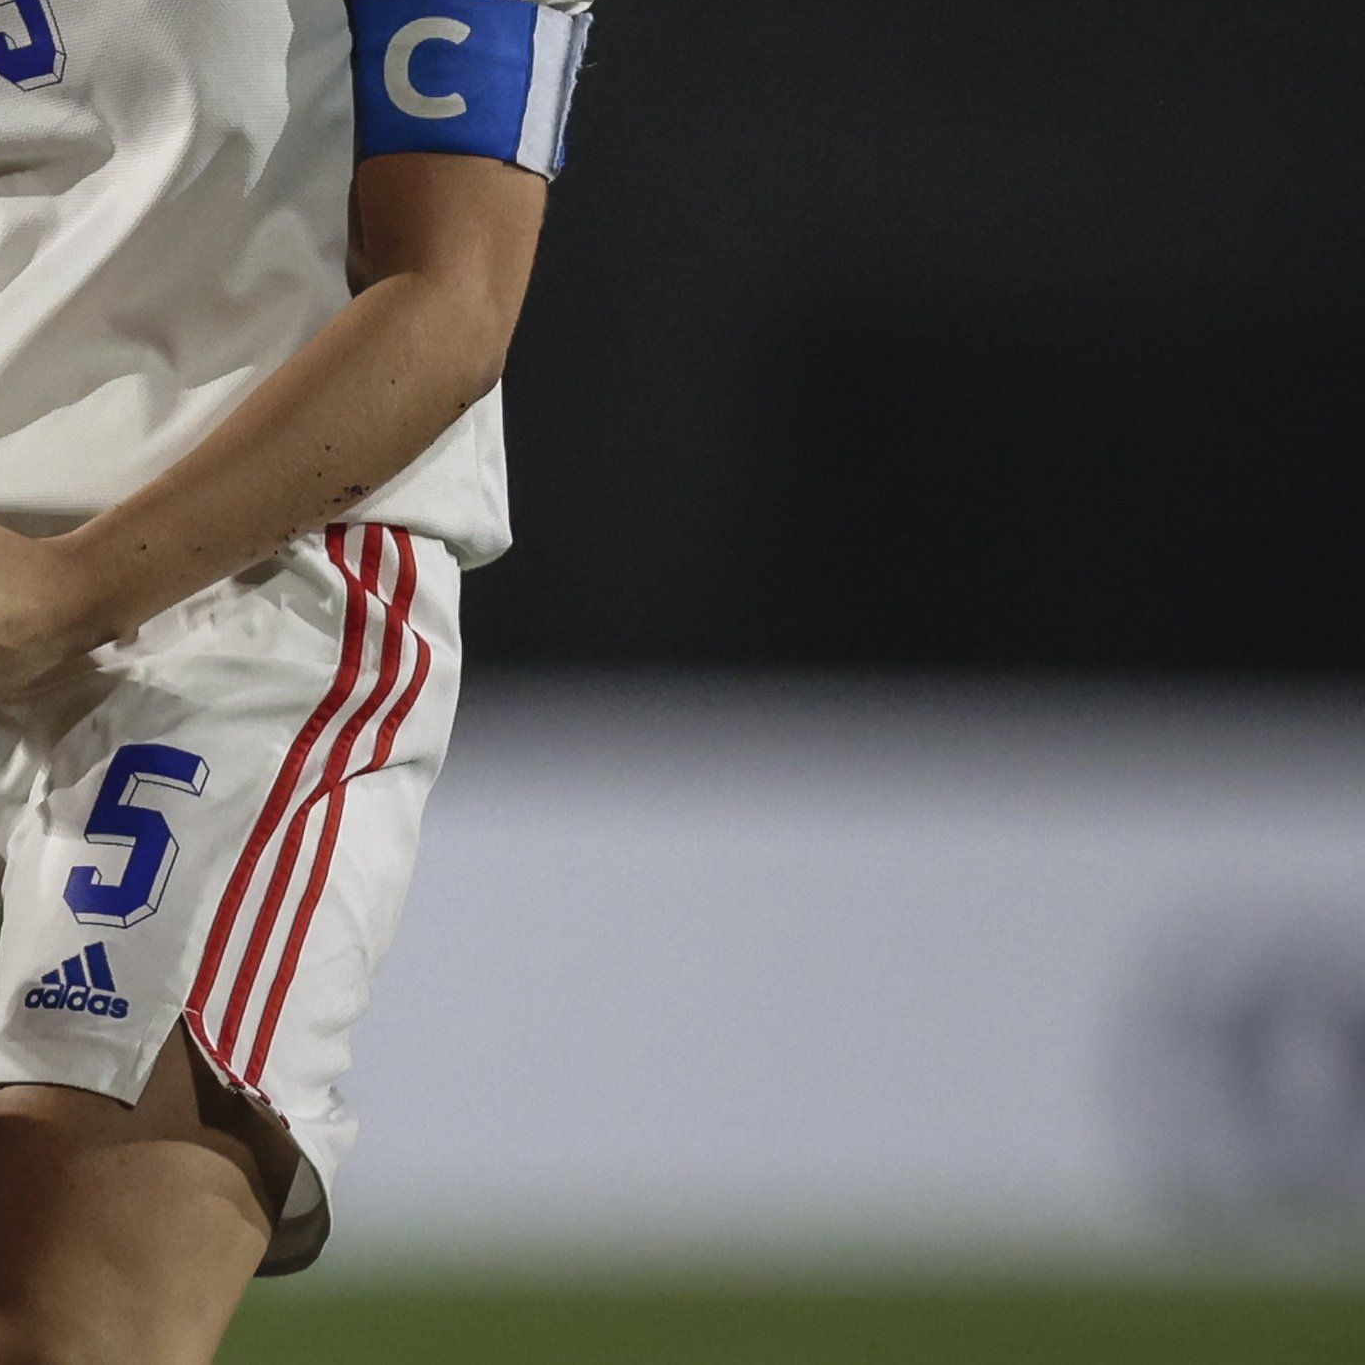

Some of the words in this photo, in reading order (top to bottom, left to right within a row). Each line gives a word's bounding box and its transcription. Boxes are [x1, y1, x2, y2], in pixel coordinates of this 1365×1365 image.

[383, 16, 471, 119] C
[63, 743, 210, 929] 5
[25, 984, 130, 1019] adidas
